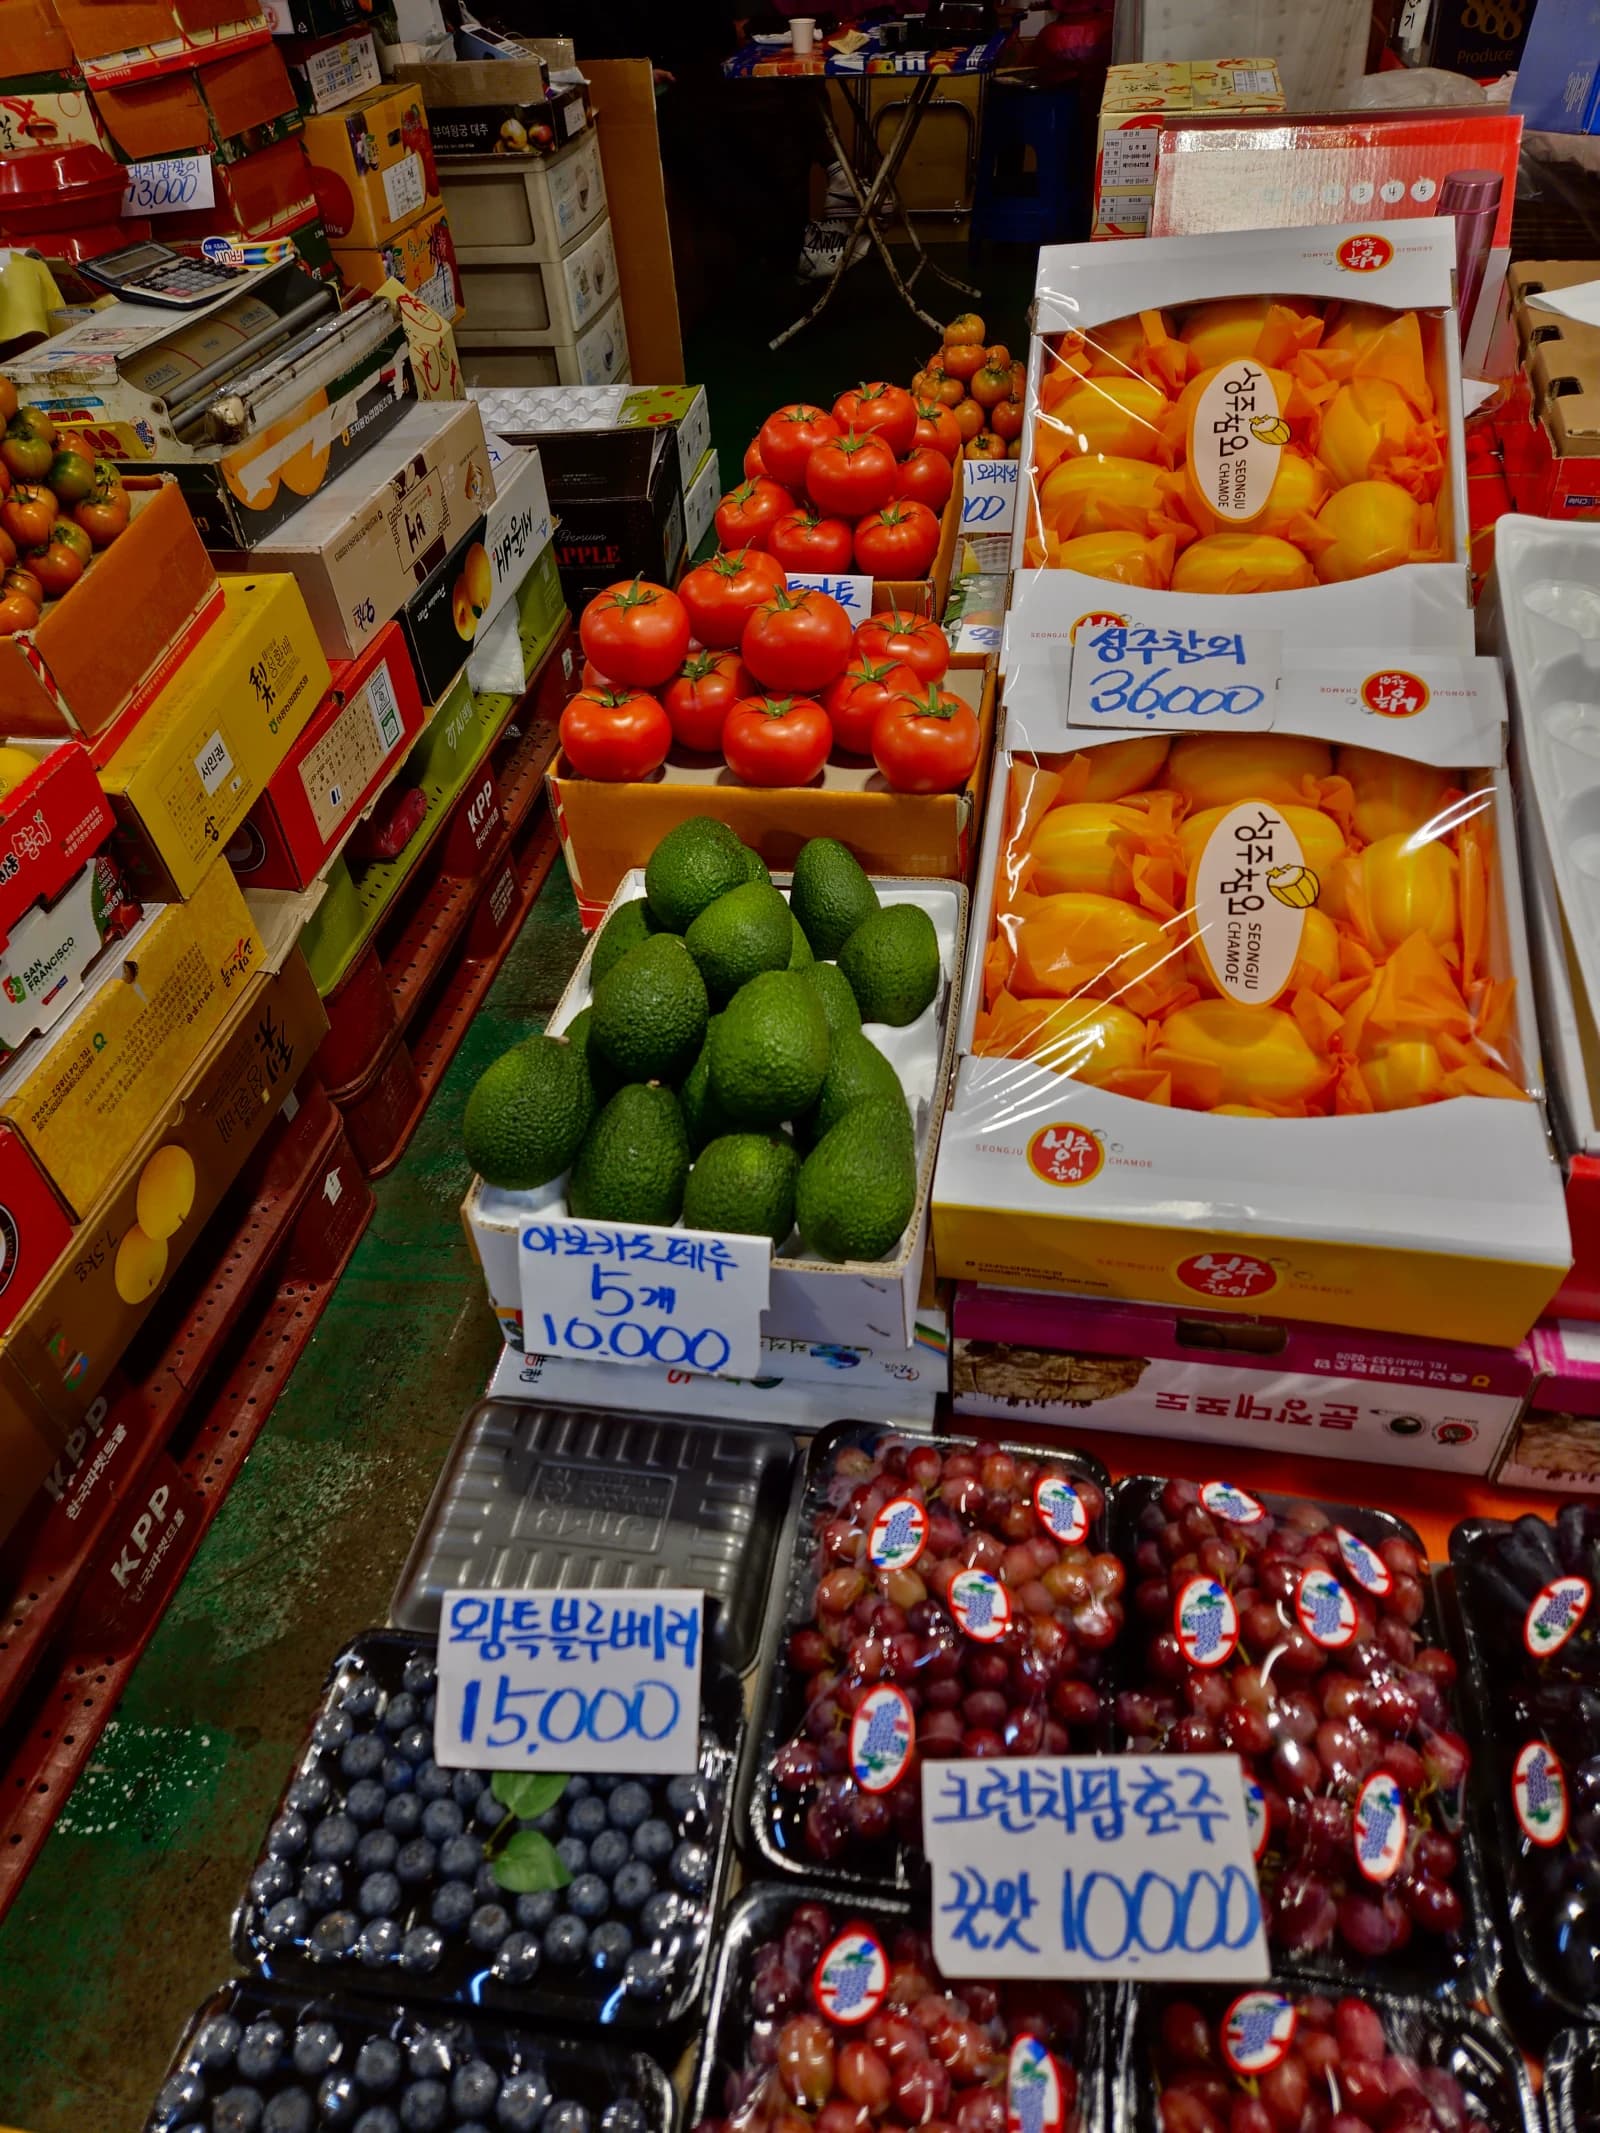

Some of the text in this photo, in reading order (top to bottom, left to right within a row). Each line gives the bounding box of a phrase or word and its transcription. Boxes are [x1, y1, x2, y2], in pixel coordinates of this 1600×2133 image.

[1457, 48, 1513, 64] Produce
[1388, 186, 1396, 197] 4
[1419, 185, 1427, 196] 5
[214, 248, 244, 264] FRUIT
[1218, 462, 1230, 508] CHAMOE
[1234, 459, 1247, 510] SEONGJU
[1030, 631, 1069, 640] SEONGJU
[1088, 627, 1246, 665] 성주참외
[1319, 685, 1358, 695] CHAMOE
[1432, 688, 1479, 698] SEONGJU
[200, 743, 226, 781] 서인권
[467, 780, 494, 833] KPP
[27, 935, 76, 994] FRANCISCO
[1224, 921, 1242, 985] CHAMOE
[1244, 922, 1262, 991] SEONGJU
[22, 957, 46, 987] SAN
[974, 1143, 1024, 1156] SEONGJU
[1041, 1129, 1093, 1163] 성주
[1046, 1161, 1083, 1182] 참외
[1108, 1156, 1154, 1169] CHAMOE
[1191, 1253, 1266, 1283] 성주
[1154, 1391, 1360, 1431] 문장대포도
[42, 1395, 109, 1502] KPP
[109, 1484, 171, 1590] KPP
